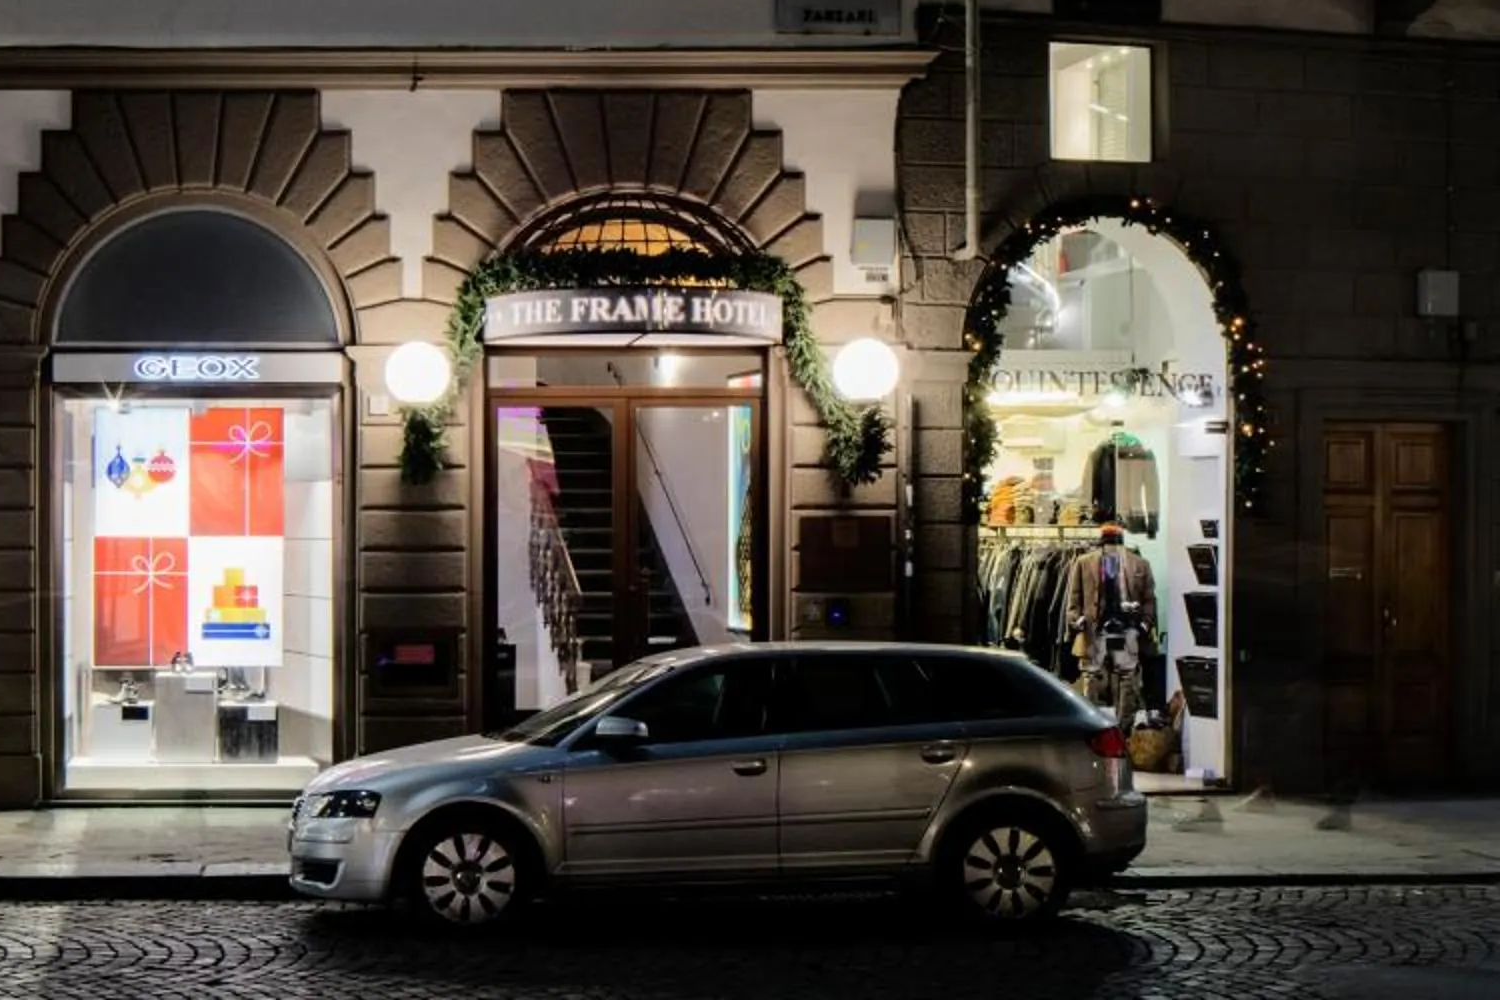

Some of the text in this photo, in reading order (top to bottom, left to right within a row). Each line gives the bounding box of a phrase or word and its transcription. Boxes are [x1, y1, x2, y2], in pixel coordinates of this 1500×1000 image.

[510, 295, 766, 328] THE FRAME HOTEL
[133, 355, 261, 380] GEOX
